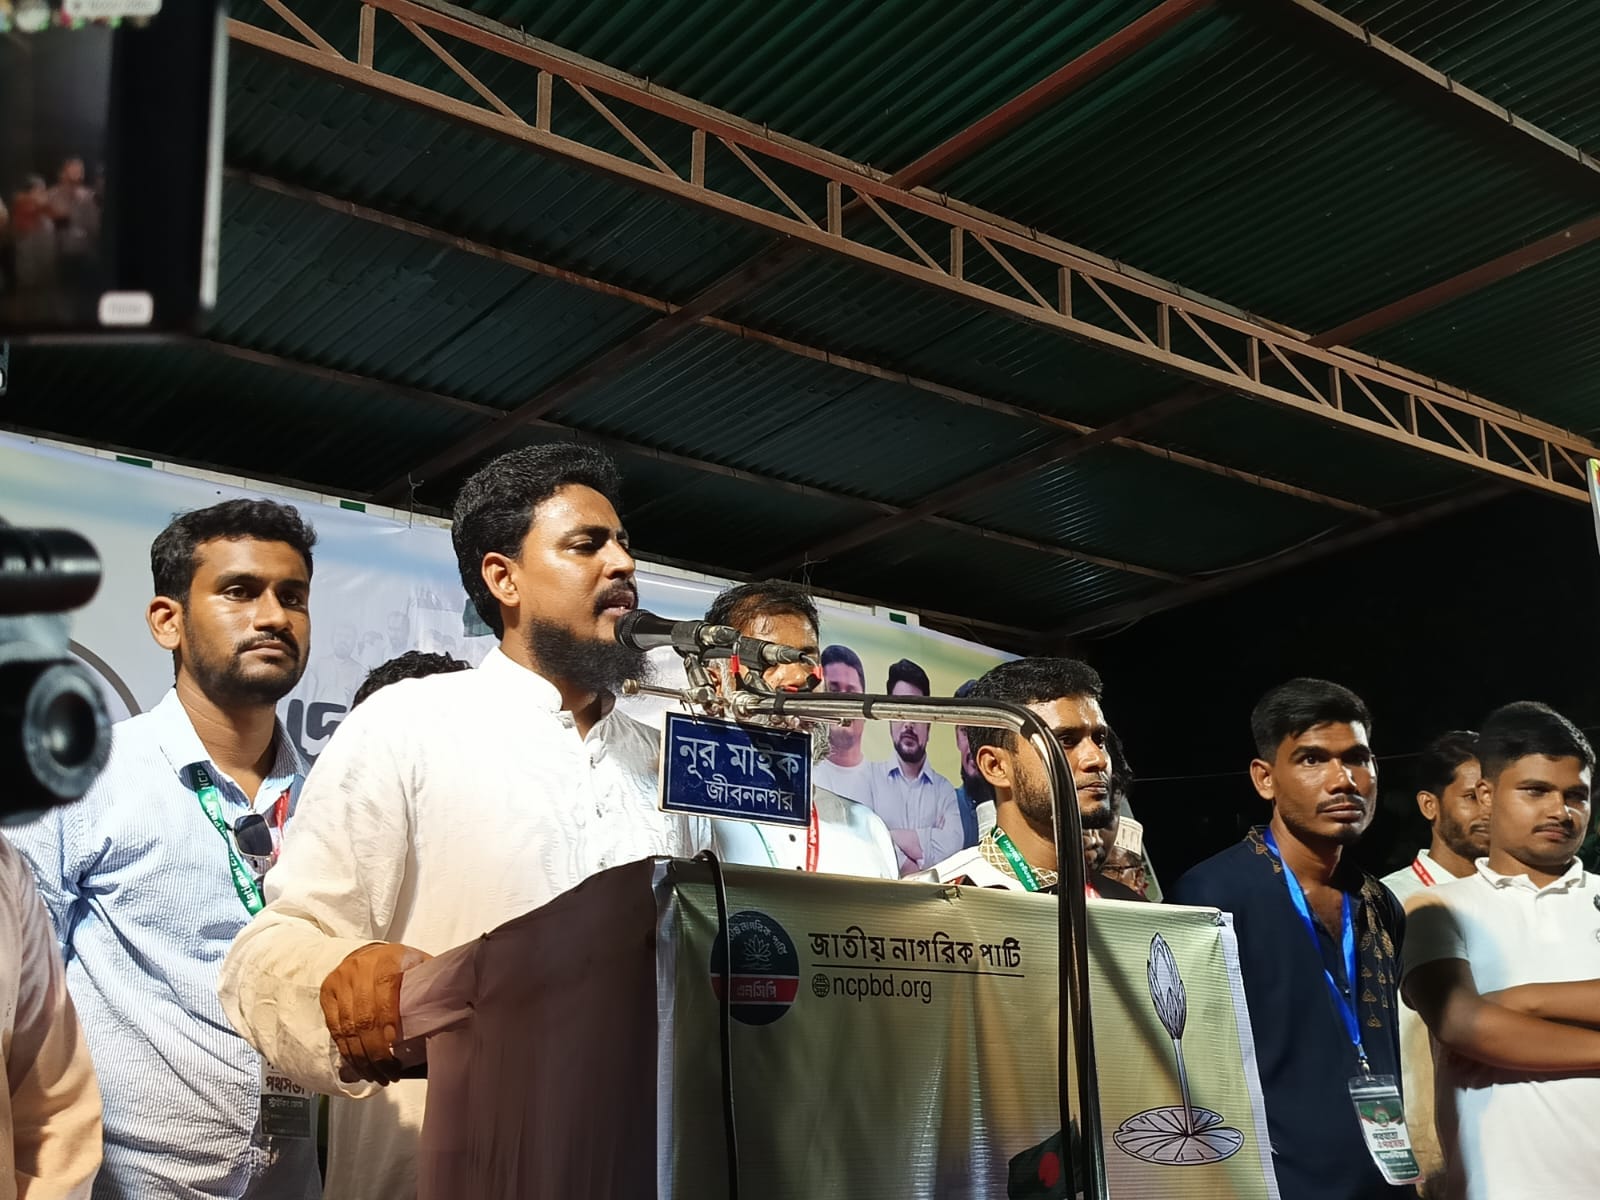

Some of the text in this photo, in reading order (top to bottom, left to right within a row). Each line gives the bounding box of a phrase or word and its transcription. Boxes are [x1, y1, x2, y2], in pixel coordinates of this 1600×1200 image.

[676, 736, 802, 781] নূর মাইক
[704, 773, 795, 812] জীবননগর
[234, 866, 258, 908] National
[808, 926, 1021, 967] জাতীয় নাগরিক পার্টি
[833, 973, 931, 1004] ncpbd.org
